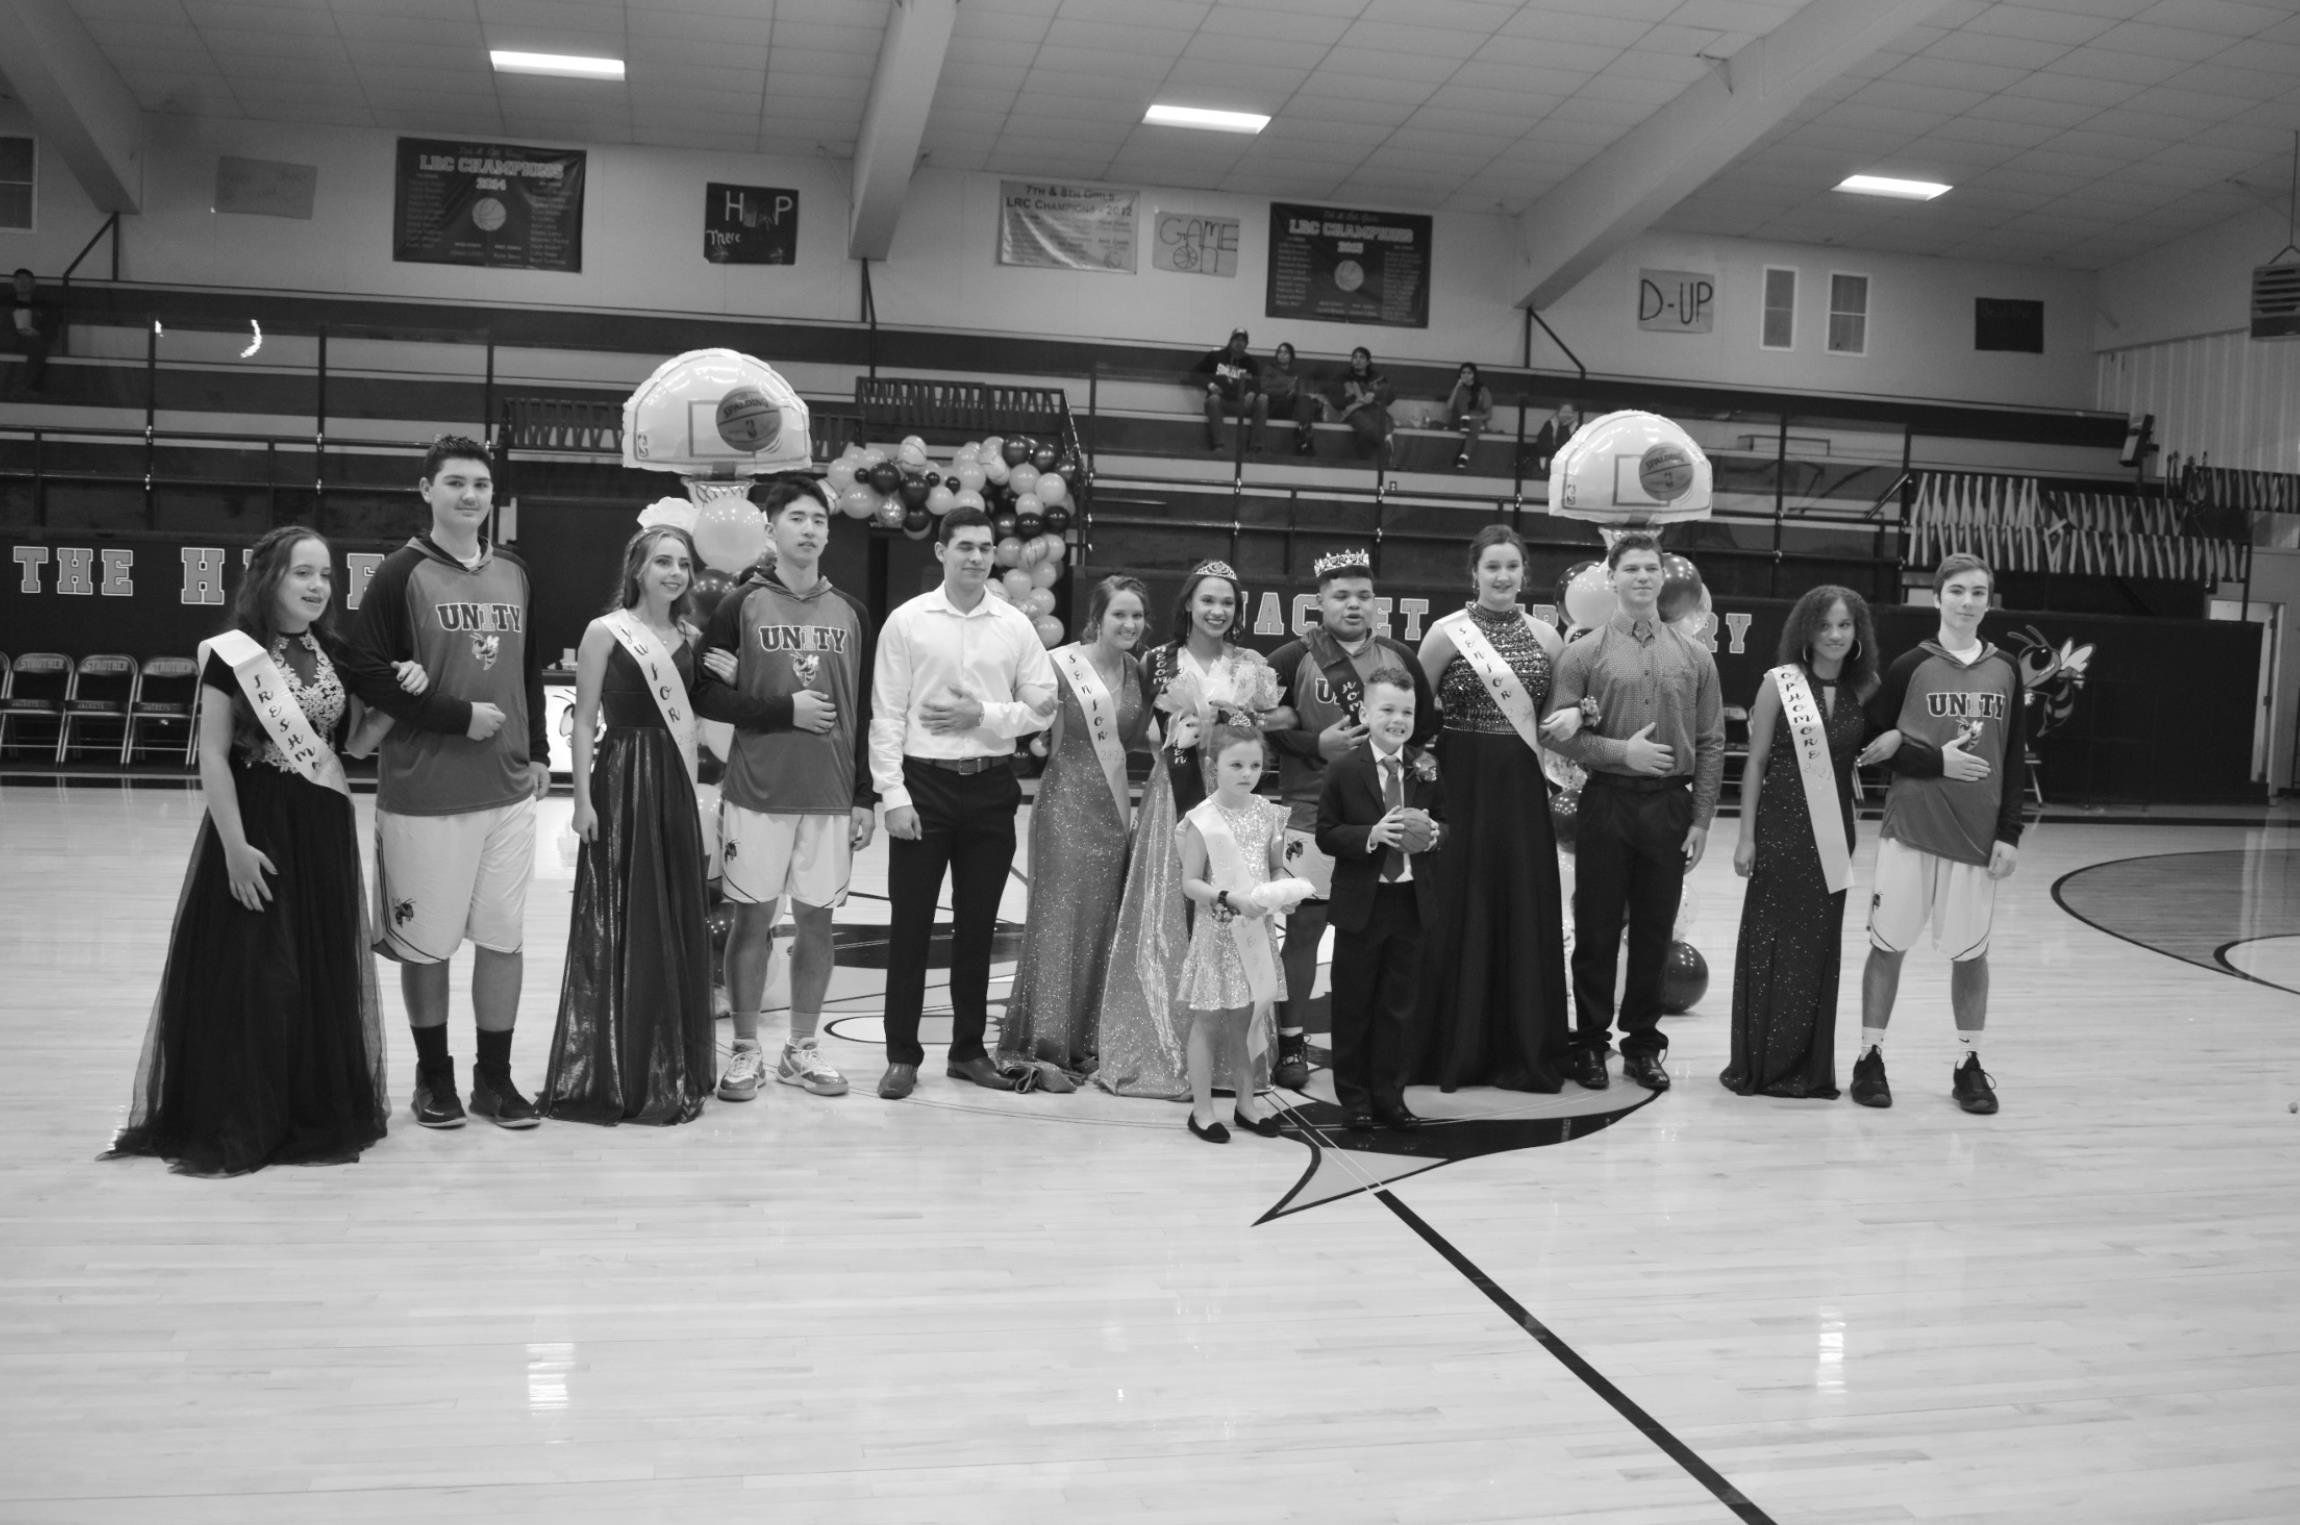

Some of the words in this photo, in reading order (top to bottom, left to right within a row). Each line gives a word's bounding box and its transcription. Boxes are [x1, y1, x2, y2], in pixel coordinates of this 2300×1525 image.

[458, 157, 564, 179] CHAMPIONS
[1005, 197, 1031, 209] LRC
[1159, 216, 1239, 252] GAME
[1322, 222, 1414, 243] CHAMPIONS
[1639, 278, 1713, 325] D-UP
[12, 545, 134, 597] THE
[1779, 665, 1820, 760] OPHOMORE
